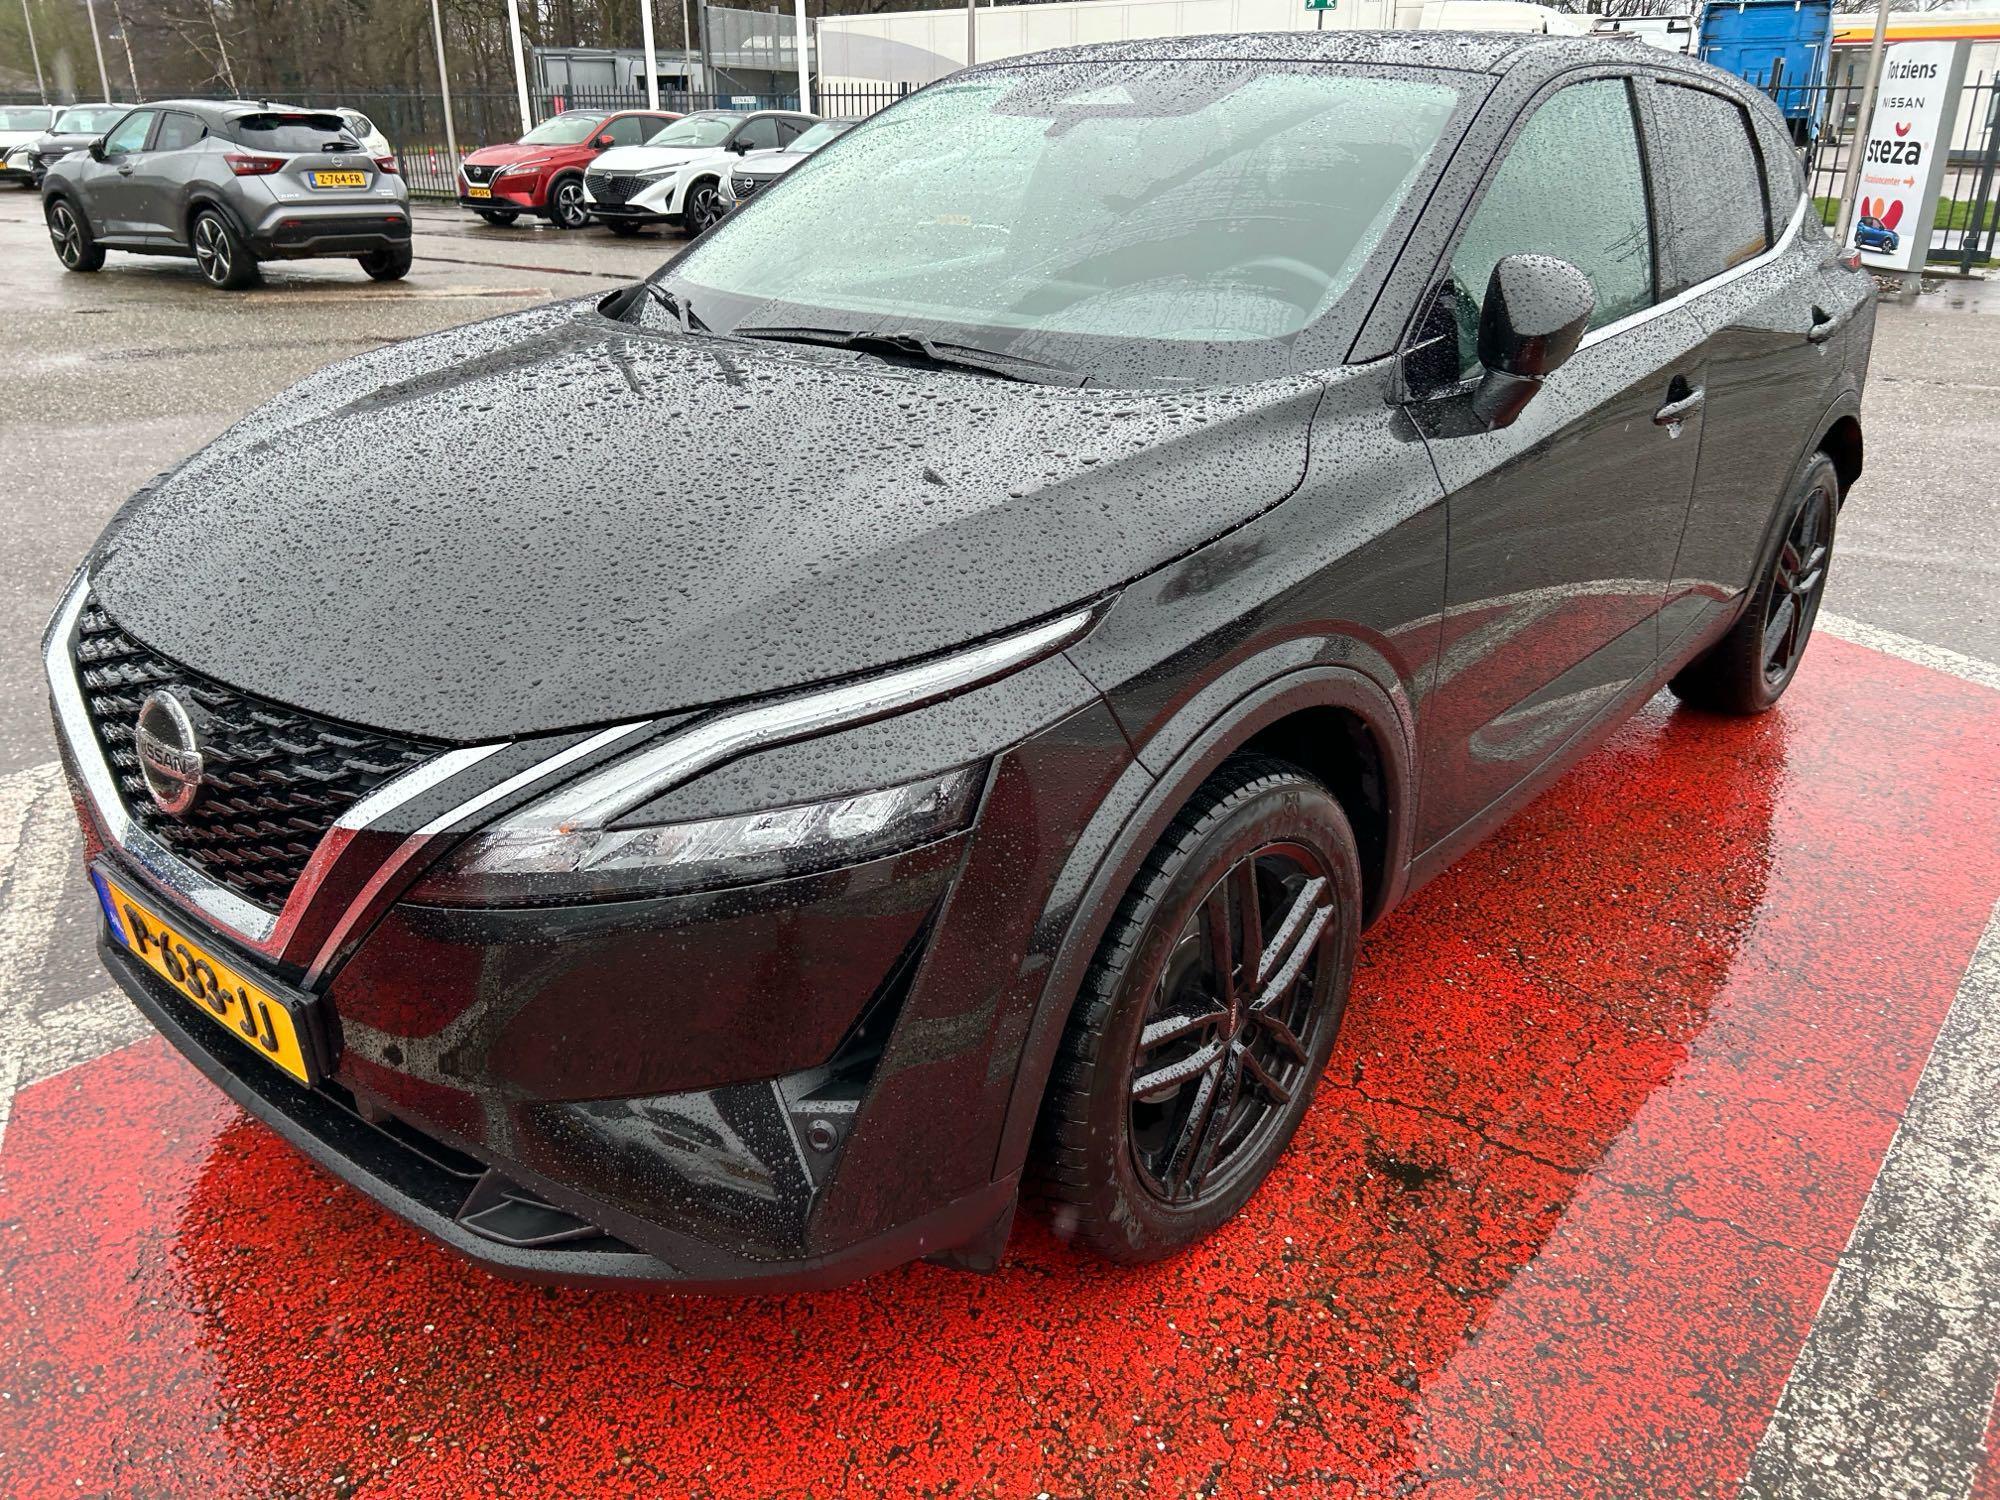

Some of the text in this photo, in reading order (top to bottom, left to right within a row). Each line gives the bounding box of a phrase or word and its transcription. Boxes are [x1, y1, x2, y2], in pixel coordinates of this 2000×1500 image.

[1887, 60, 1937, 79] Tot ziens
[1882, 97, 1925, 108] NISSAN
[1867, 139, 1921, 165] steza
[319, 174, 361, 184] Z-764-FR
[123, 902, 279, 1053] P-633-JJ
